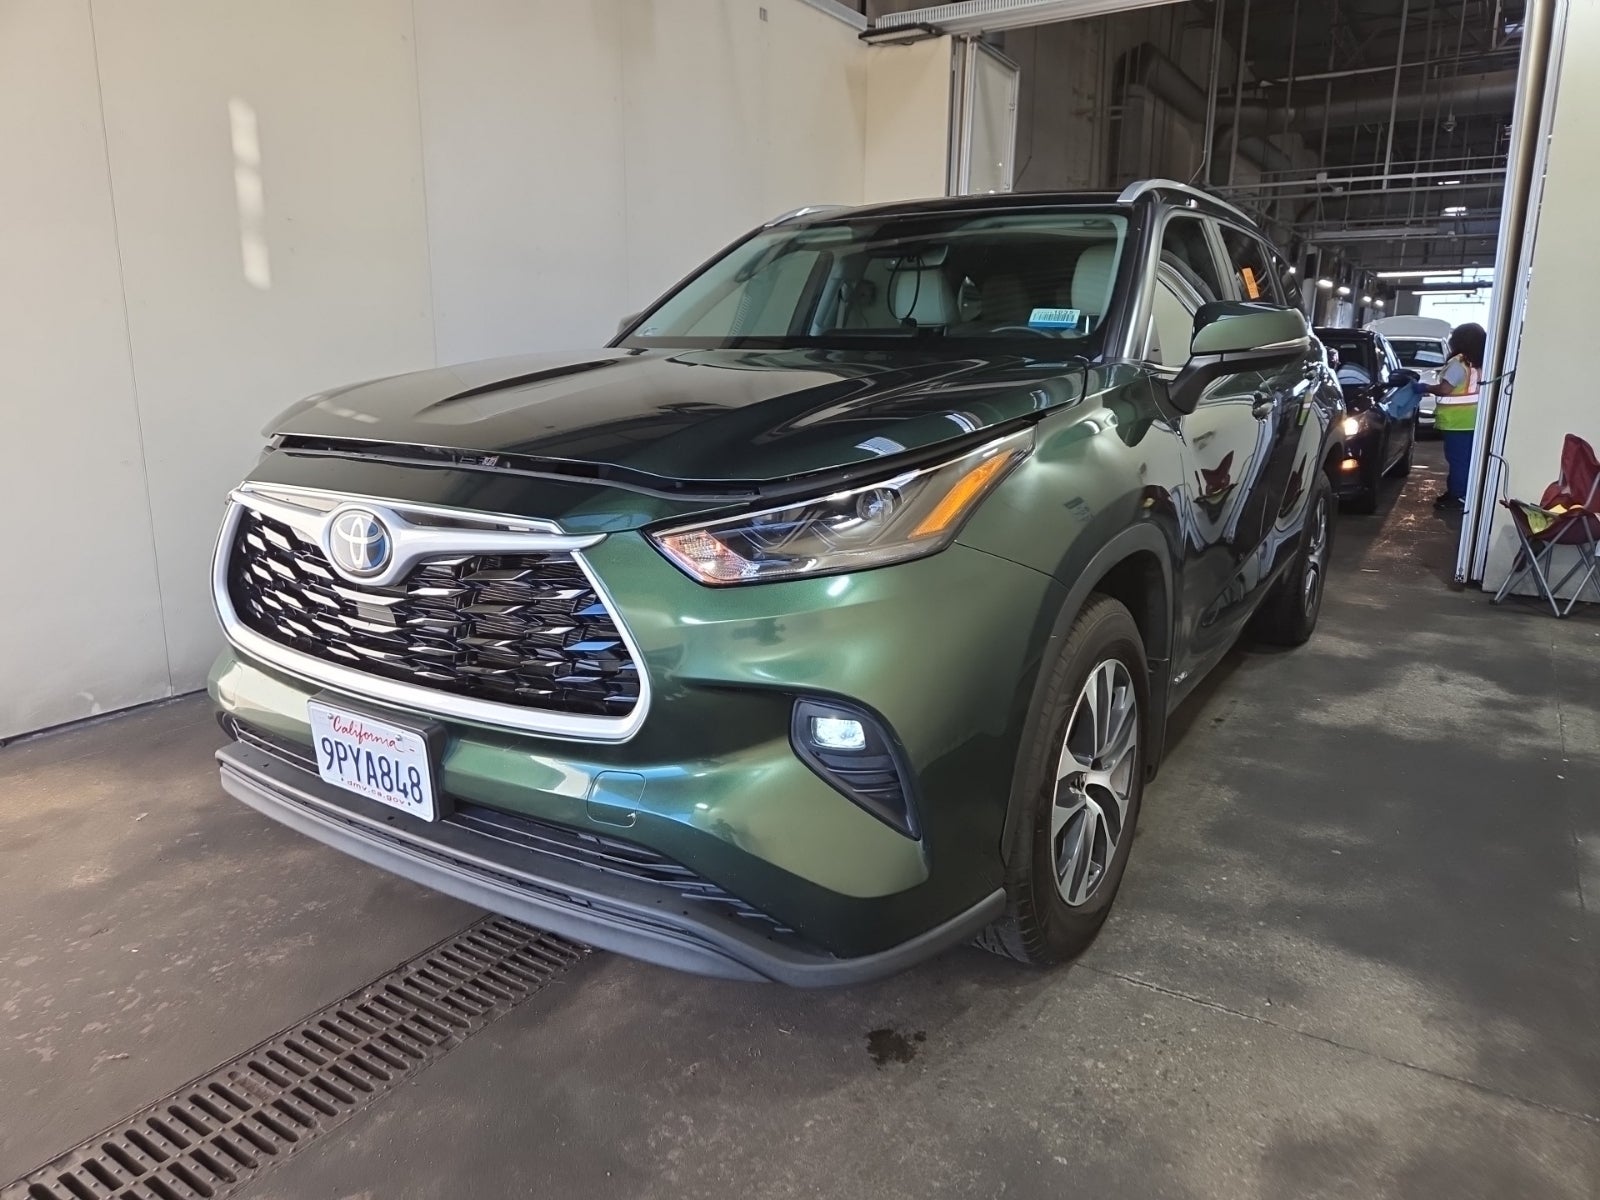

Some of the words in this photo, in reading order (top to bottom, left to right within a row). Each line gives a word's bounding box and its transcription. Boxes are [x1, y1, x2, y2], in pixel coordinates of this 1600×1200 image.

[333, 715, 402, 752] California
[321, 737, 423, 804] 9PYA848
[347, 780, 405, 805] dmv.ca.gov
